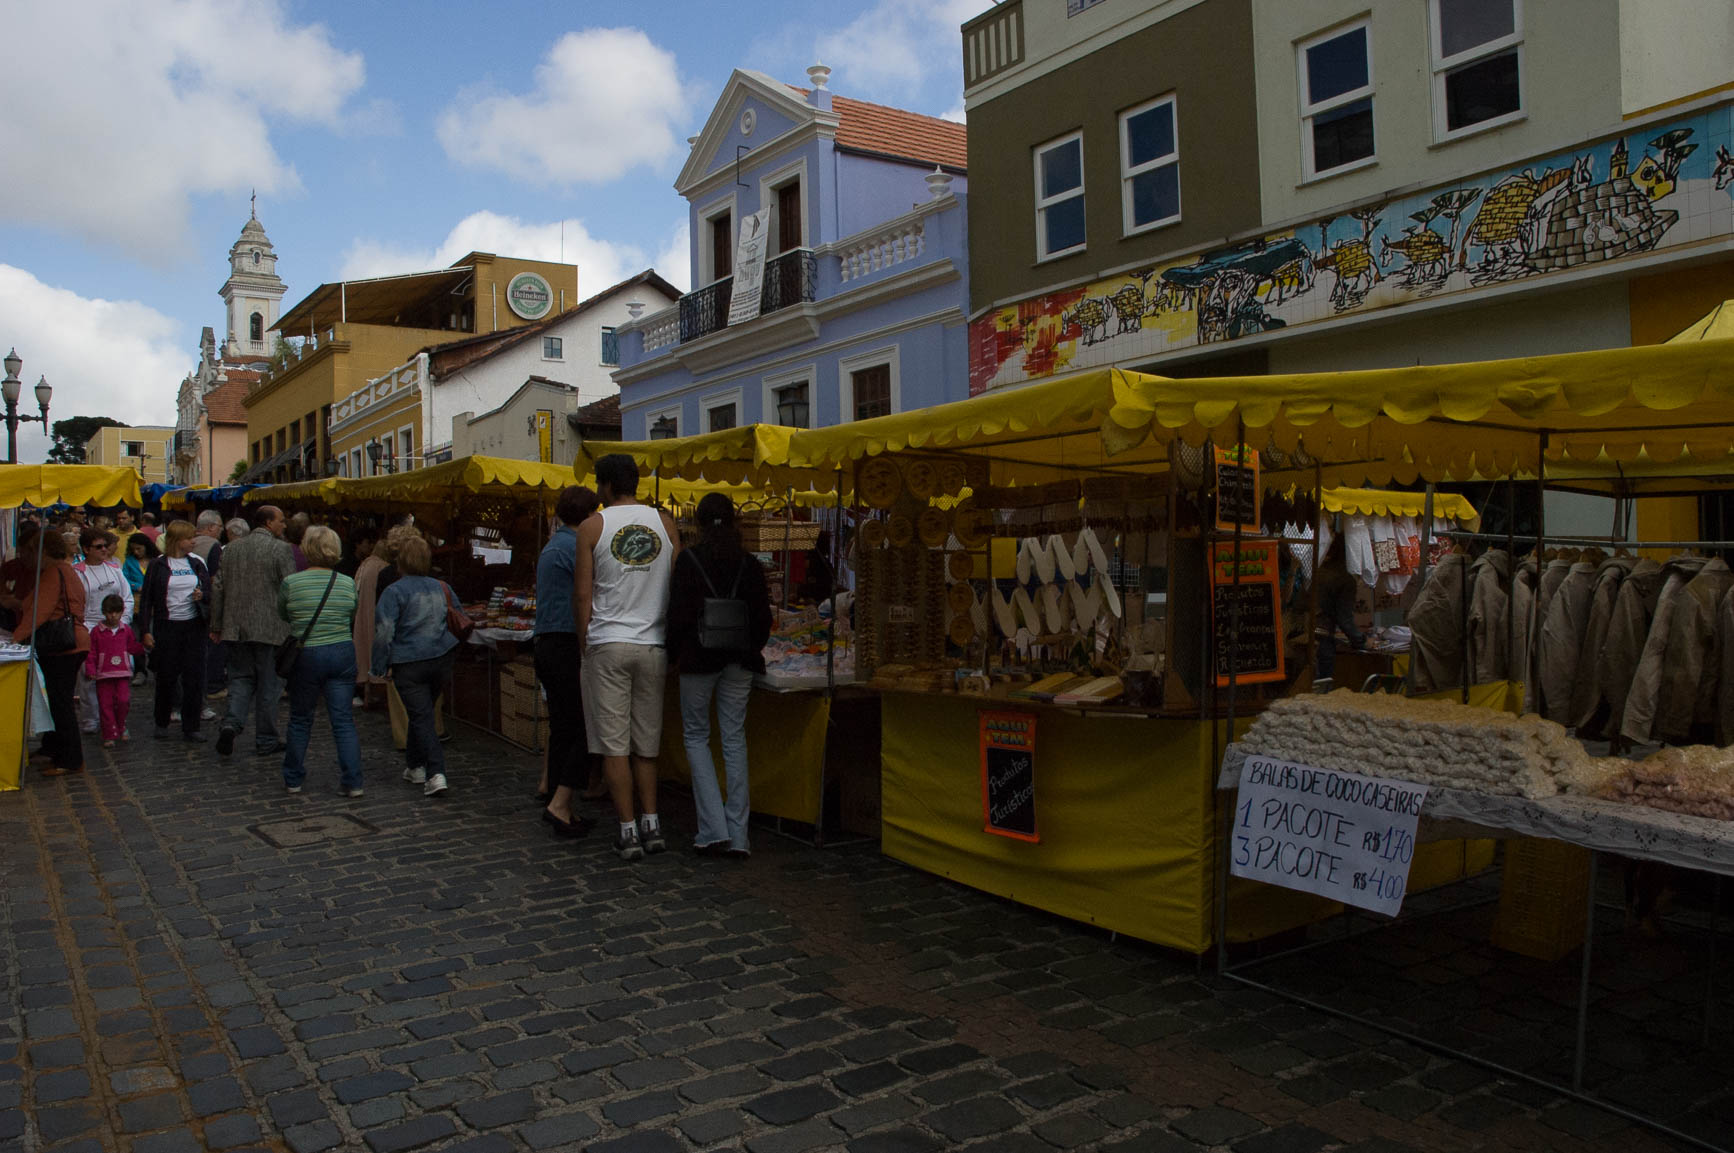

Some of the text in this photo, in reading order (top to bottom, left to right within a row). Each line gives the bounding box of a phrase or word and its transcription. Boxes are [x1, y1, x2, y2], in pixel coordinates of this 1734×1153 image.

[513, 290, 546, 301] Heineken
[992, 732, 1025, 745] TEM
[989, 757, 1029, 795] Produtos
[1248, 761, 1423, 816] BALAS DE COCO CASEIRAS
[990, 782, 1033, 824] Turístico
[1240, 798, 1252, 828] 1
[1261, 798, 1355, 848] PACOTE
[1235, 836, 1250, 866] 3
[1254, 836, 1345, 885] PACOTE
